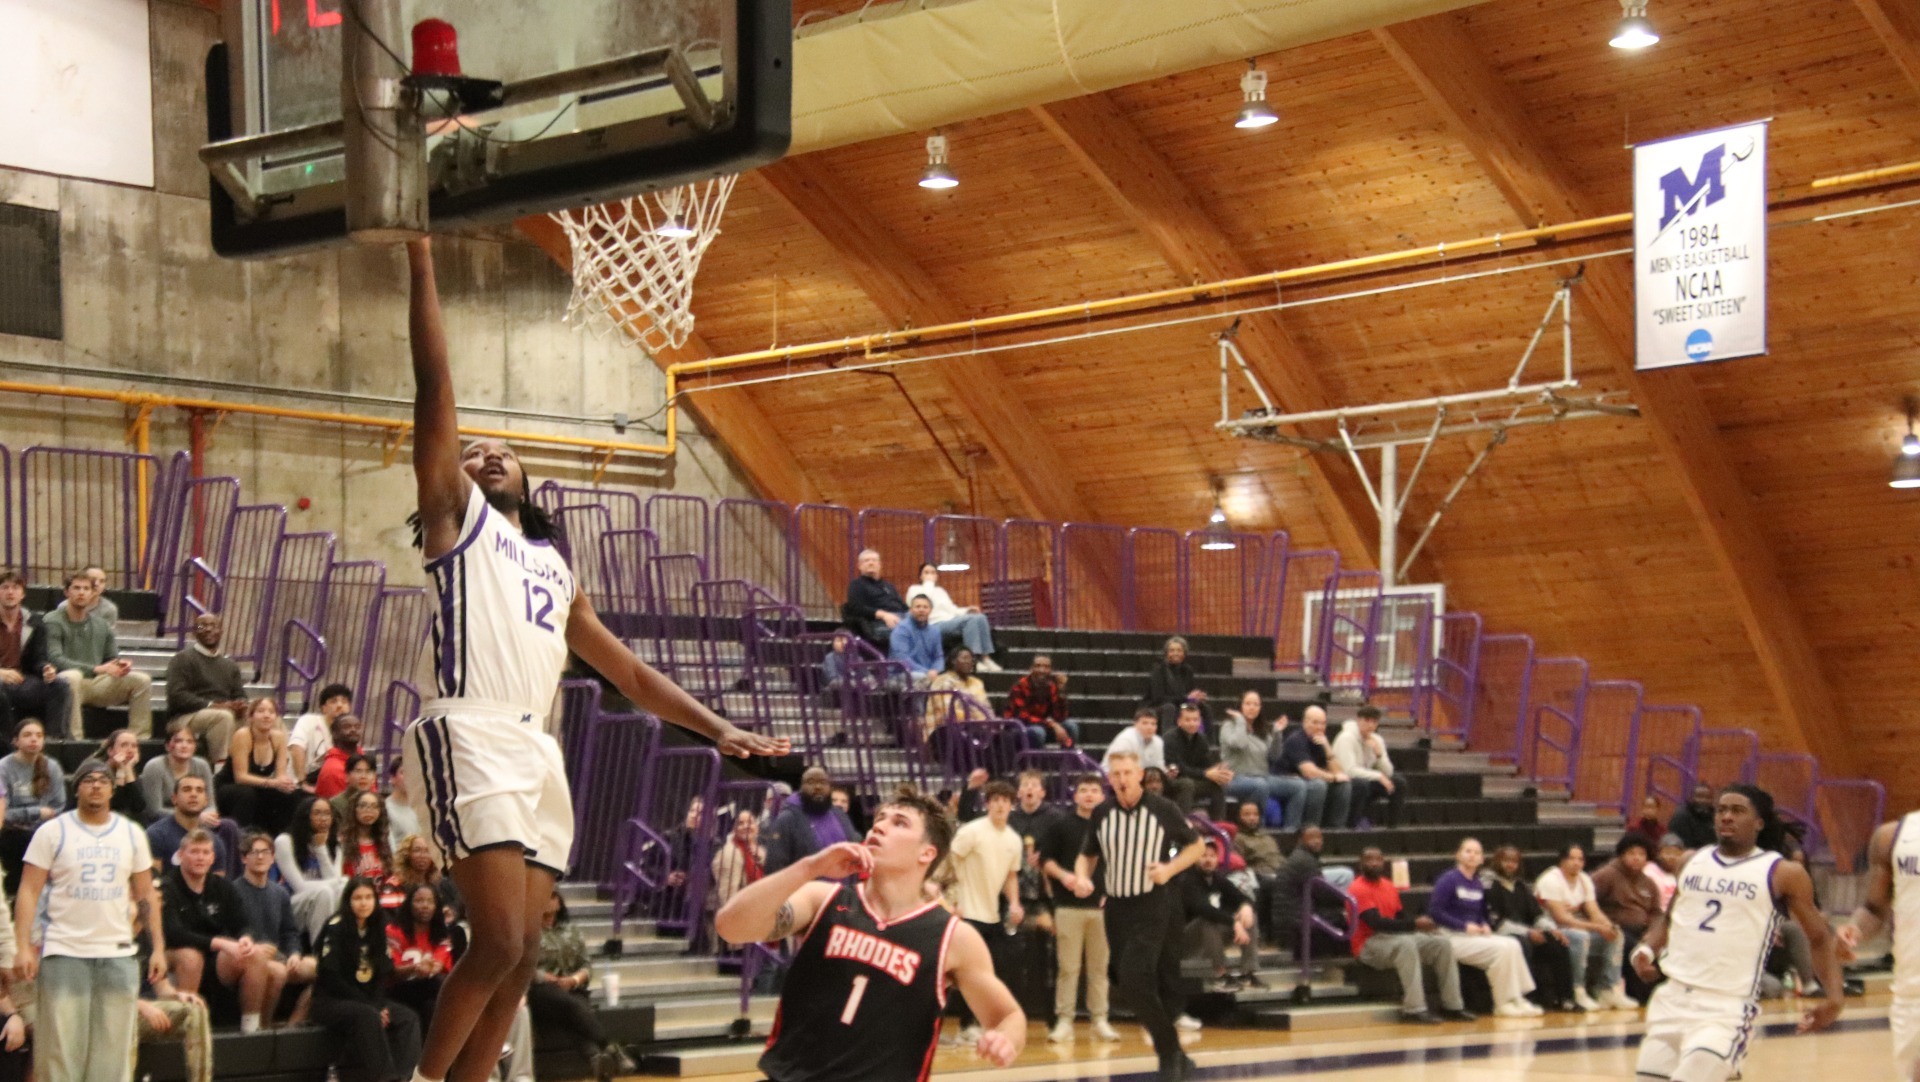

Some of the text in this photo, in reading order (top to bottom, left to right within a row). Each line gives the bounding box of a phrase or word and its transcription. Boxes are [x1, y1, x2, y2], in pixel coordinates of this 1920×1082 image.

[1680, 223, 1720, 251] 1984
[1684, 244, 1750, 269] BASKETBALL
[1676, 269, 1723, 302] NCAA
[522, 578, 555, 634] 12
[76, 846, 121, 862] NORTH
[80, 863, 117, 884] 23
[1682, 874, 1759, 901] MILLSAPS
[1698, 899, 1723, 933] 2
[825, 924, 921, 985] RHODES
[841, 975, 868, 1025] 1
